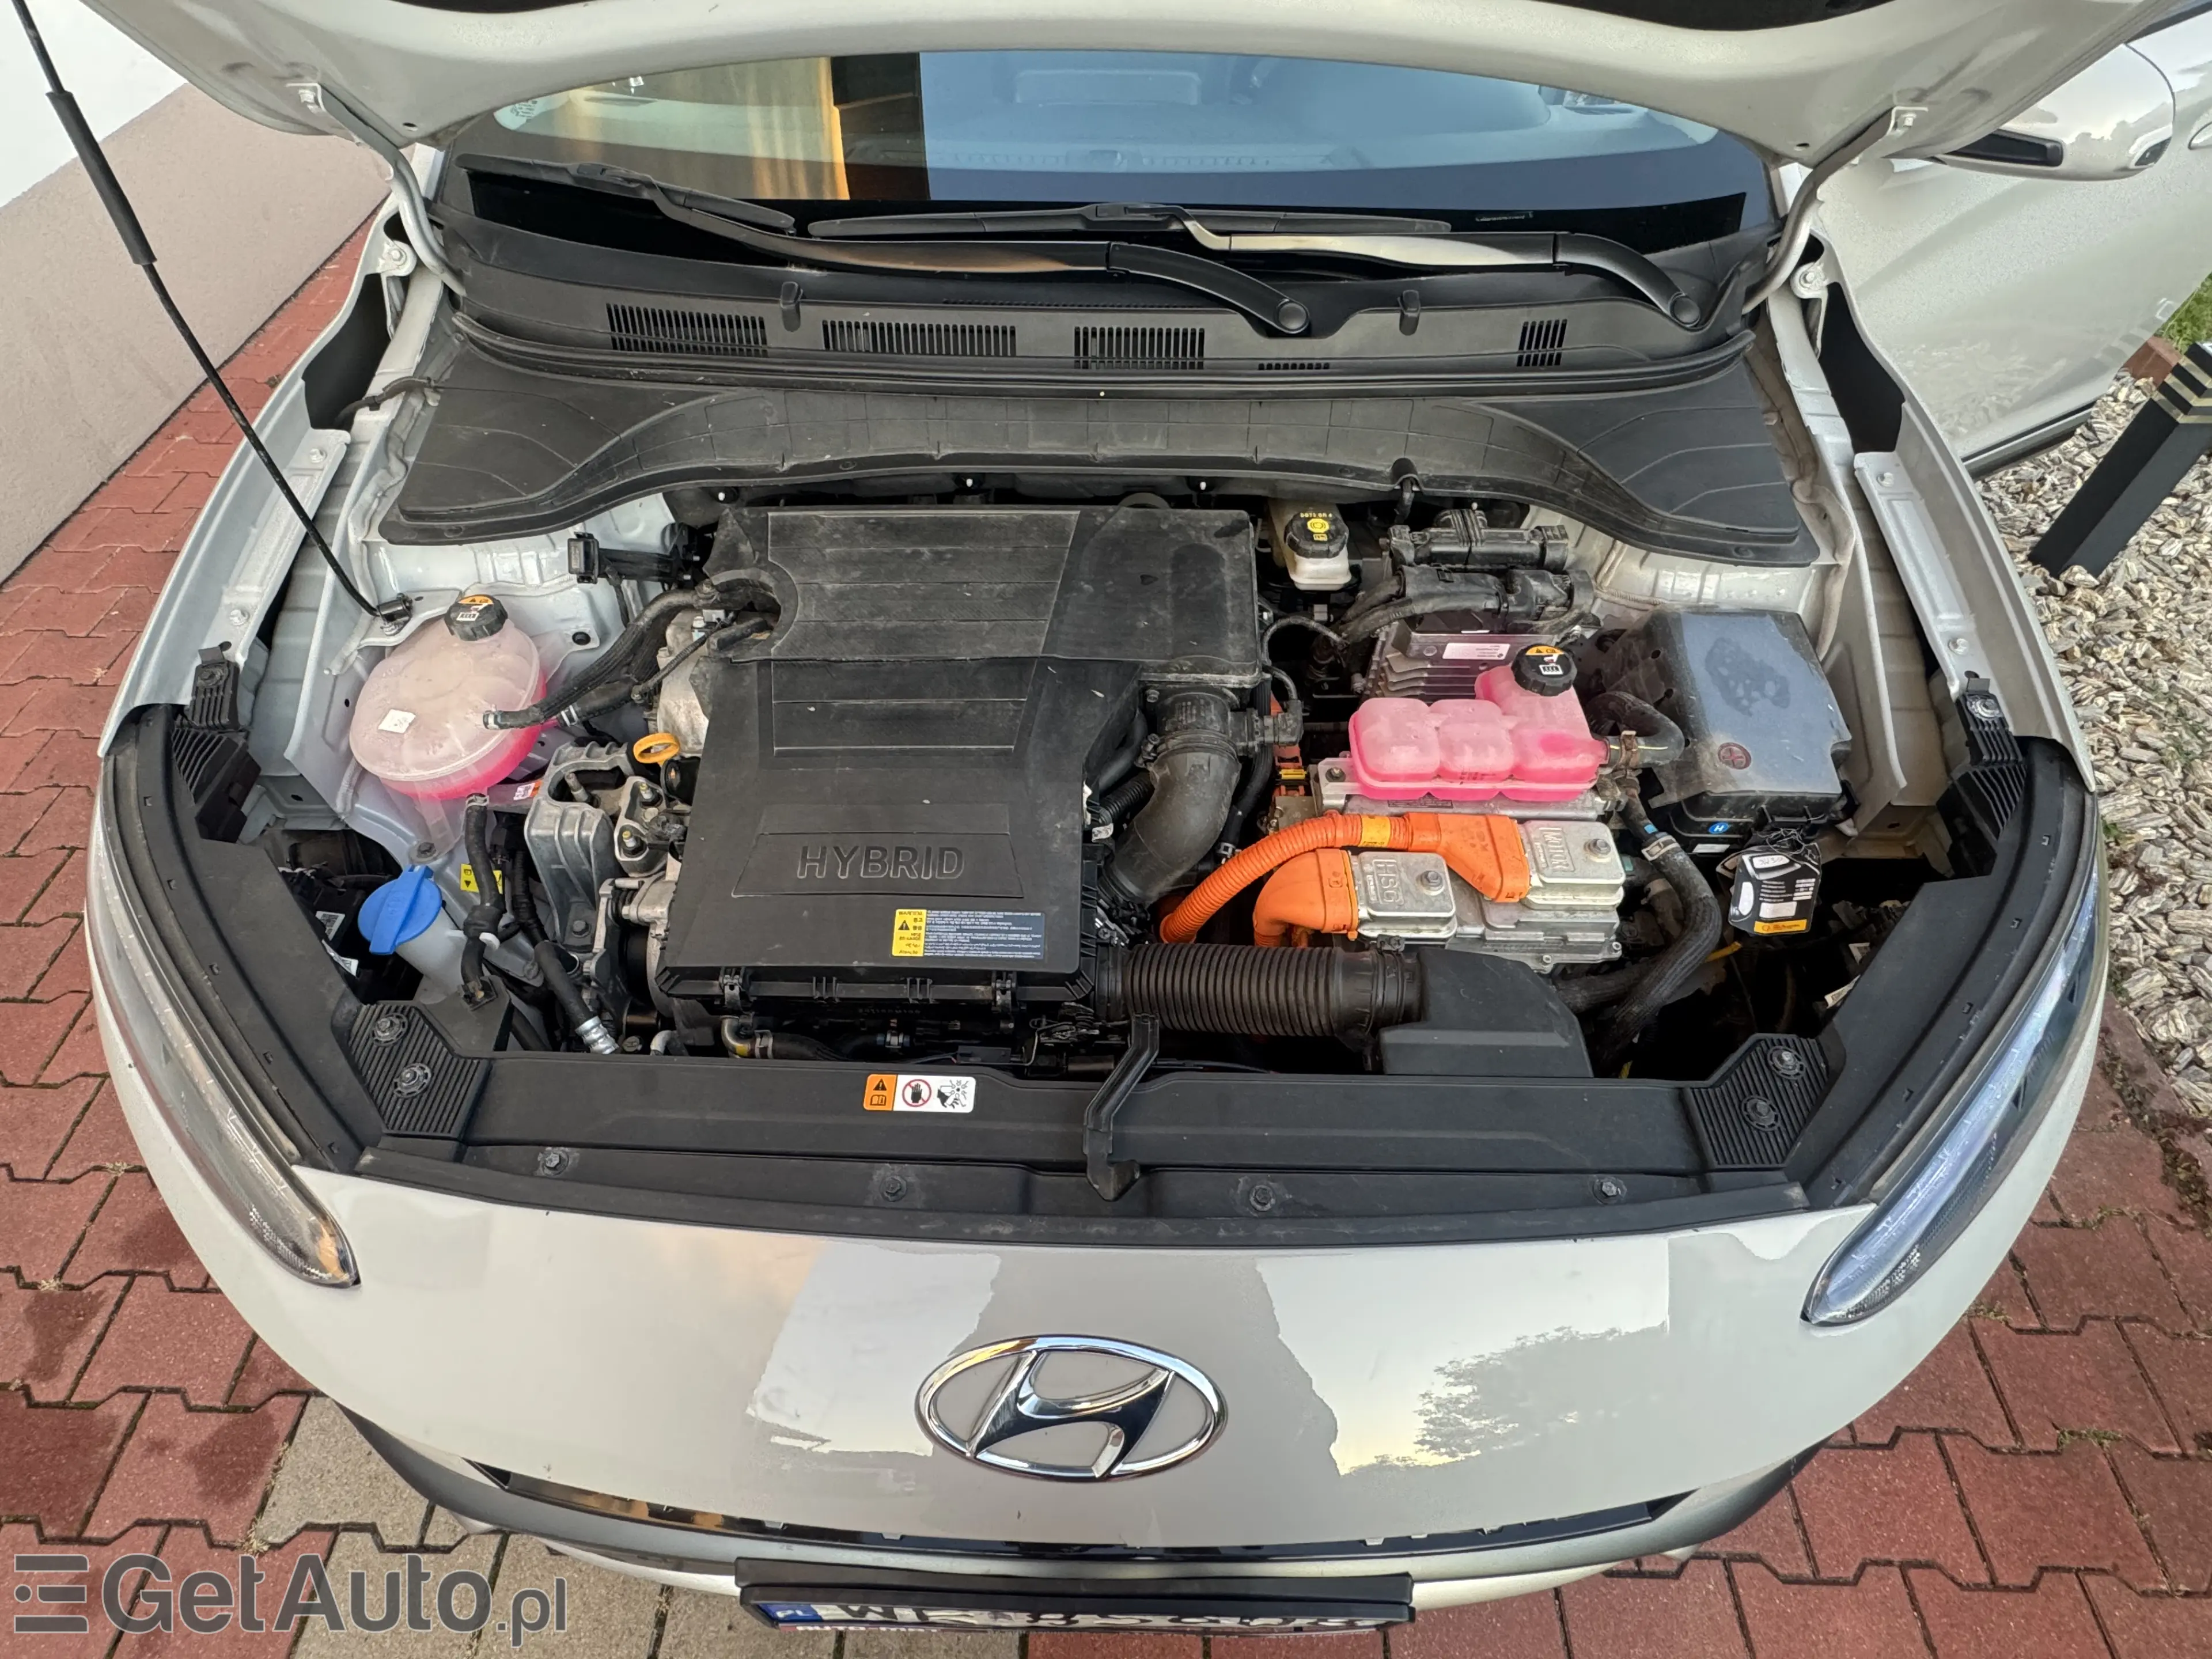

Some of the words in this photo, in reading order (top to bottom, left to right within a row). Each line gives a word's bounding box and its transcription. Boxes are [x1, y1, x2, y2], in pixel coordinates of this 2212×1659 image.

[796, 844, 965, 880] HYBRID
[1375, 863, 1399, 903] HSG
[775, 1609, 812, 1619] PL
